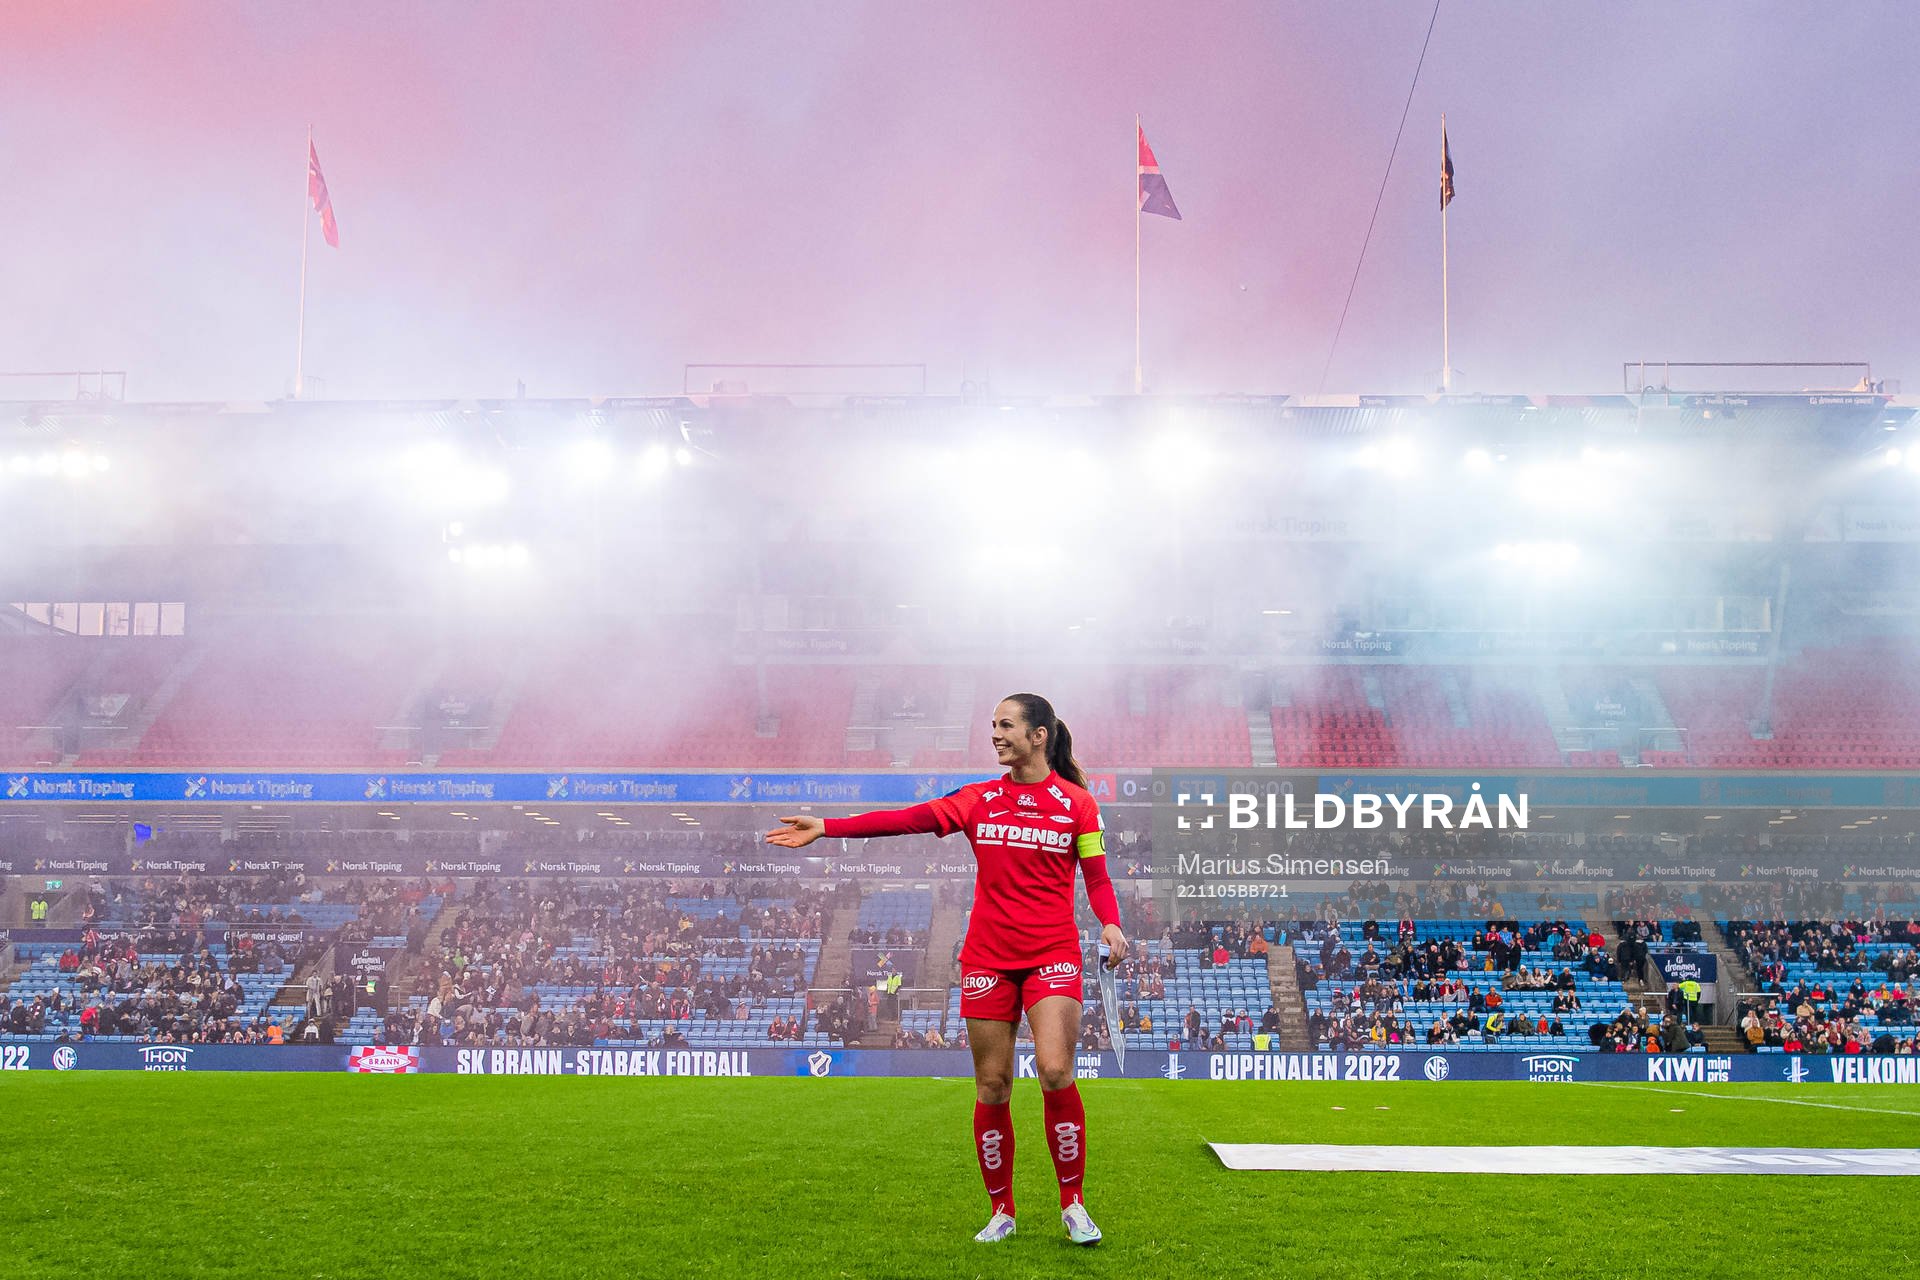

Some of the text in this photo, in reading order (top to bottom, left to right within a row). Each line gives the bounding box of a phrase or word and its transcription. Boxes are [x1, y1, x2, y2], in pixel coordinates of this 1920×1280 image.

[1322, 638, 1392, 651] Norsk Tipping
[33, 780, 135, 798] Norsk Tipping
[211, 780, 314, 798] Norsk Tipping
[976, 823, 1073, 847] FRYDENBØ
[49, 860, 108, 873] Norsk Tipping
[146, 861, 205, 874] Norsk Tipping
[244, 861, 270, 871] Norsk
[342, 861, 402, 874] Norsk Tipping
[440, 861, 501, 874] Norsk Tipping
[540, 861, 601, 874] Norsk Tipping
[639, 861, 700, 874] Norsk Tipping
[739, 861, 801, 874] Norsk Tipping
[839, 862, 901, 875] Norsk Tipping
[941, 862, 968, 873] Norsk
[1449, 865, 1511, 878] Norsk Tipping
[1551, 865, 1614, 878] Norsk Tipping
[1653, 866, 1716, 879] Norsk Tipping
[1785, 866, 1819, 879] Tipping
[1859, 867, 1920, 880] Norsk Tipping
[1039, 962, 1080, 977] LERØY
[962, 976, 997, 989] LERØY
[141, 1047, 190, 1063] THON
[368, 1057, 400, 1066] BRANN
[1077, 1054, 1101, 1067] mini
[456, 1048, 485, 1074] SK
[491, 1049, 562, 1075] BRANN
[576, 1049, 662, 1076] STABÆK
[665, 1050, 751, 1077] FOTBALL
[1210, 1054, 1400, 1081] CUPFINALEN 2022
[1525, 1056, 1576, 1073] THON
[1707, 1057, 1732, 1070] mini
[1648, 1057, 1704, 1082] KIWI
[1707, 1070, 1729, 1082] pris
[1831, 1057, 1920, 1083] VELKOM
